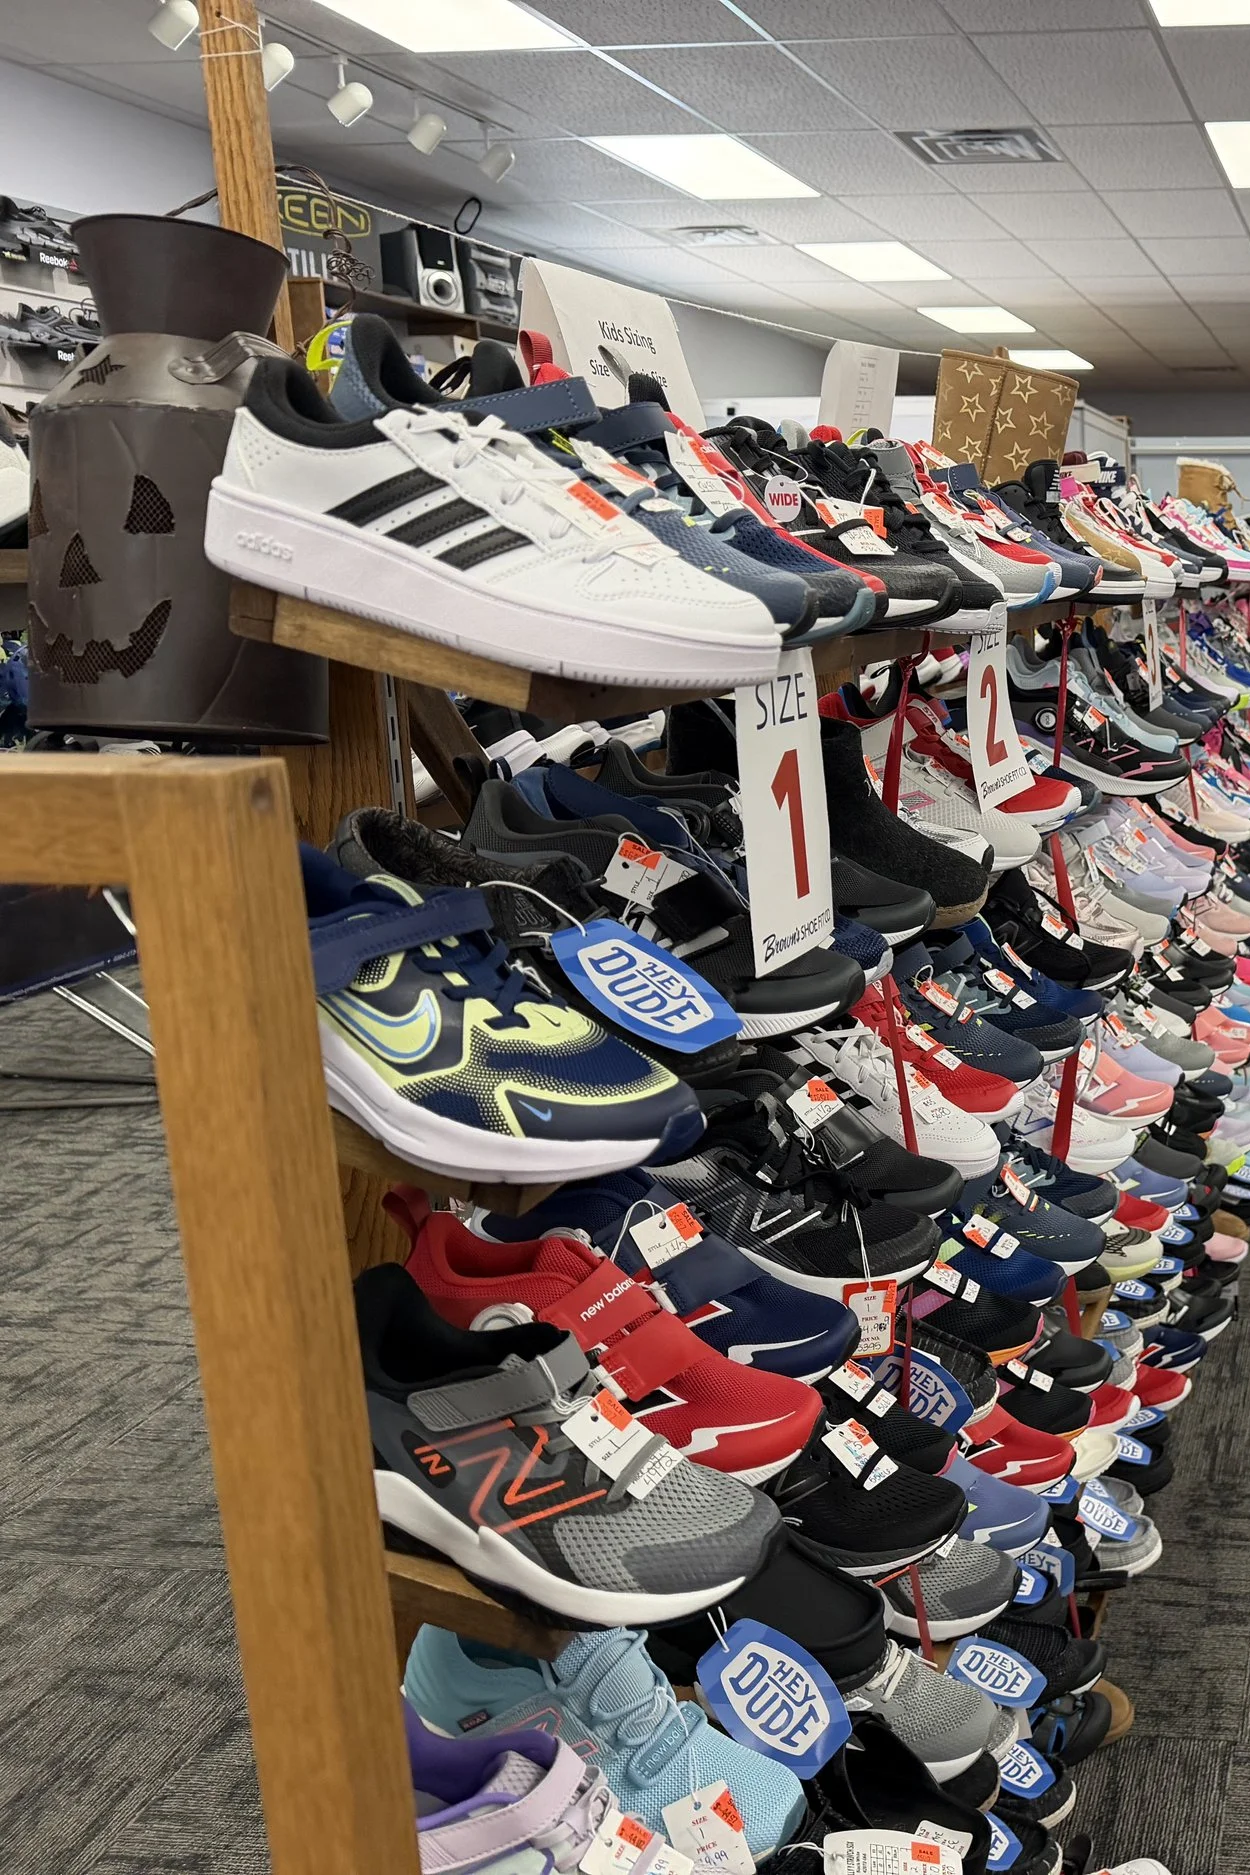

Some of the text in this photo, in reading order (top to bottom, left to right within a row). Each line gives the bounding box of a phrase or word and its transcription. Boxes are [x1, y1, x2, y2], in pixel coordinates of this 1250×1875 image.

[597, 319, 657, 355] Kids Sizing
[590, 359, 611, 377] Size
[769, 492, 798, 507] WIDE
[236, 530, 294, 561] adidas
[756, 672, 808, 730] SIZE
[980, 664, 1009, 767] 2
[771, 748, 811, 900] 1
[630, 880, 642, 894] STYLE
[646, 890, 656, 901] SIZE
[762, 925, 801, 963] Brown's
[800, 918, 819, 943] SHOE
[588, 946, 701, 1027] DUDE
[642, 961, 695, 1001] HEY
[681, 1210, 695, 1228] SALE
[580, 1276, 637, 1322] new balan
[882, 1363, 947, 1423] DDE
[910, 1367, 944, 1397] HEY
[607, 1398, 624, 1416] SALE
[588, 1436, 602, 1448] STYLE
[601, 1451, 613, 1461] SIZE
[1081, 1497, 1125, 1535] DUDE
[963, 1648, 1030, 1695] DUDE
[989, 1650, 1019, 1671] HEY
[773, 1659, 817, 1708] HEY
[728, 1652, 819, 1748] DUDE
[645, 1746, 667, 1769] new
[692, 1815, 708, 1827] SIZE
[696, 1840, 718, 1854] PRICE
